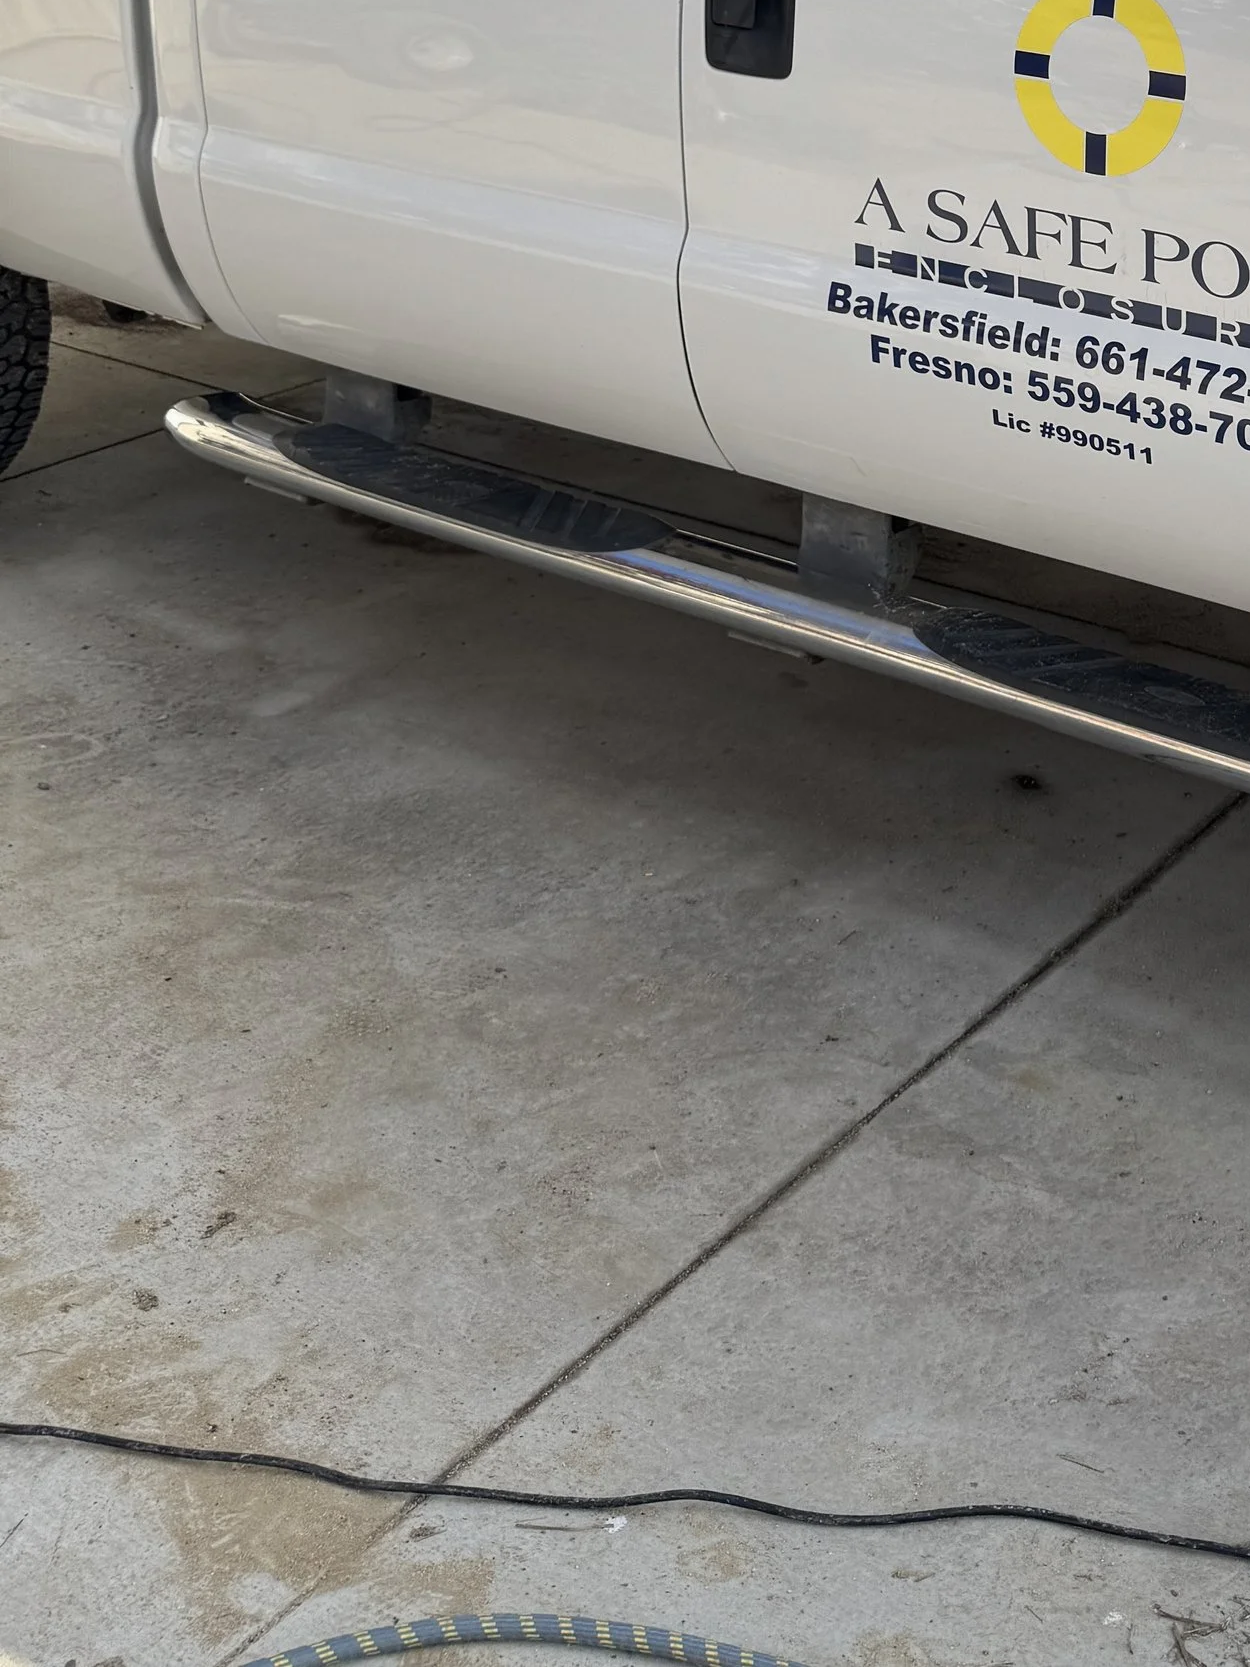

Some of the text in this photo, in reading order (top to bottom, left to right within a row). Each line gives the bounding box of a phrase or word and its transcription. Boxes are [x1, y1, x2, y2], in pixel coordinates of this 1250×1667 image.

[854, 177, 906, 234] A
[926, 189, 1118, 275] SAFE
[827, 281, 1061, 362] Bakersfield:
[870, 334, 1013, 395] Fresno:
[992, 408, 1153, 465] Lic #990511
